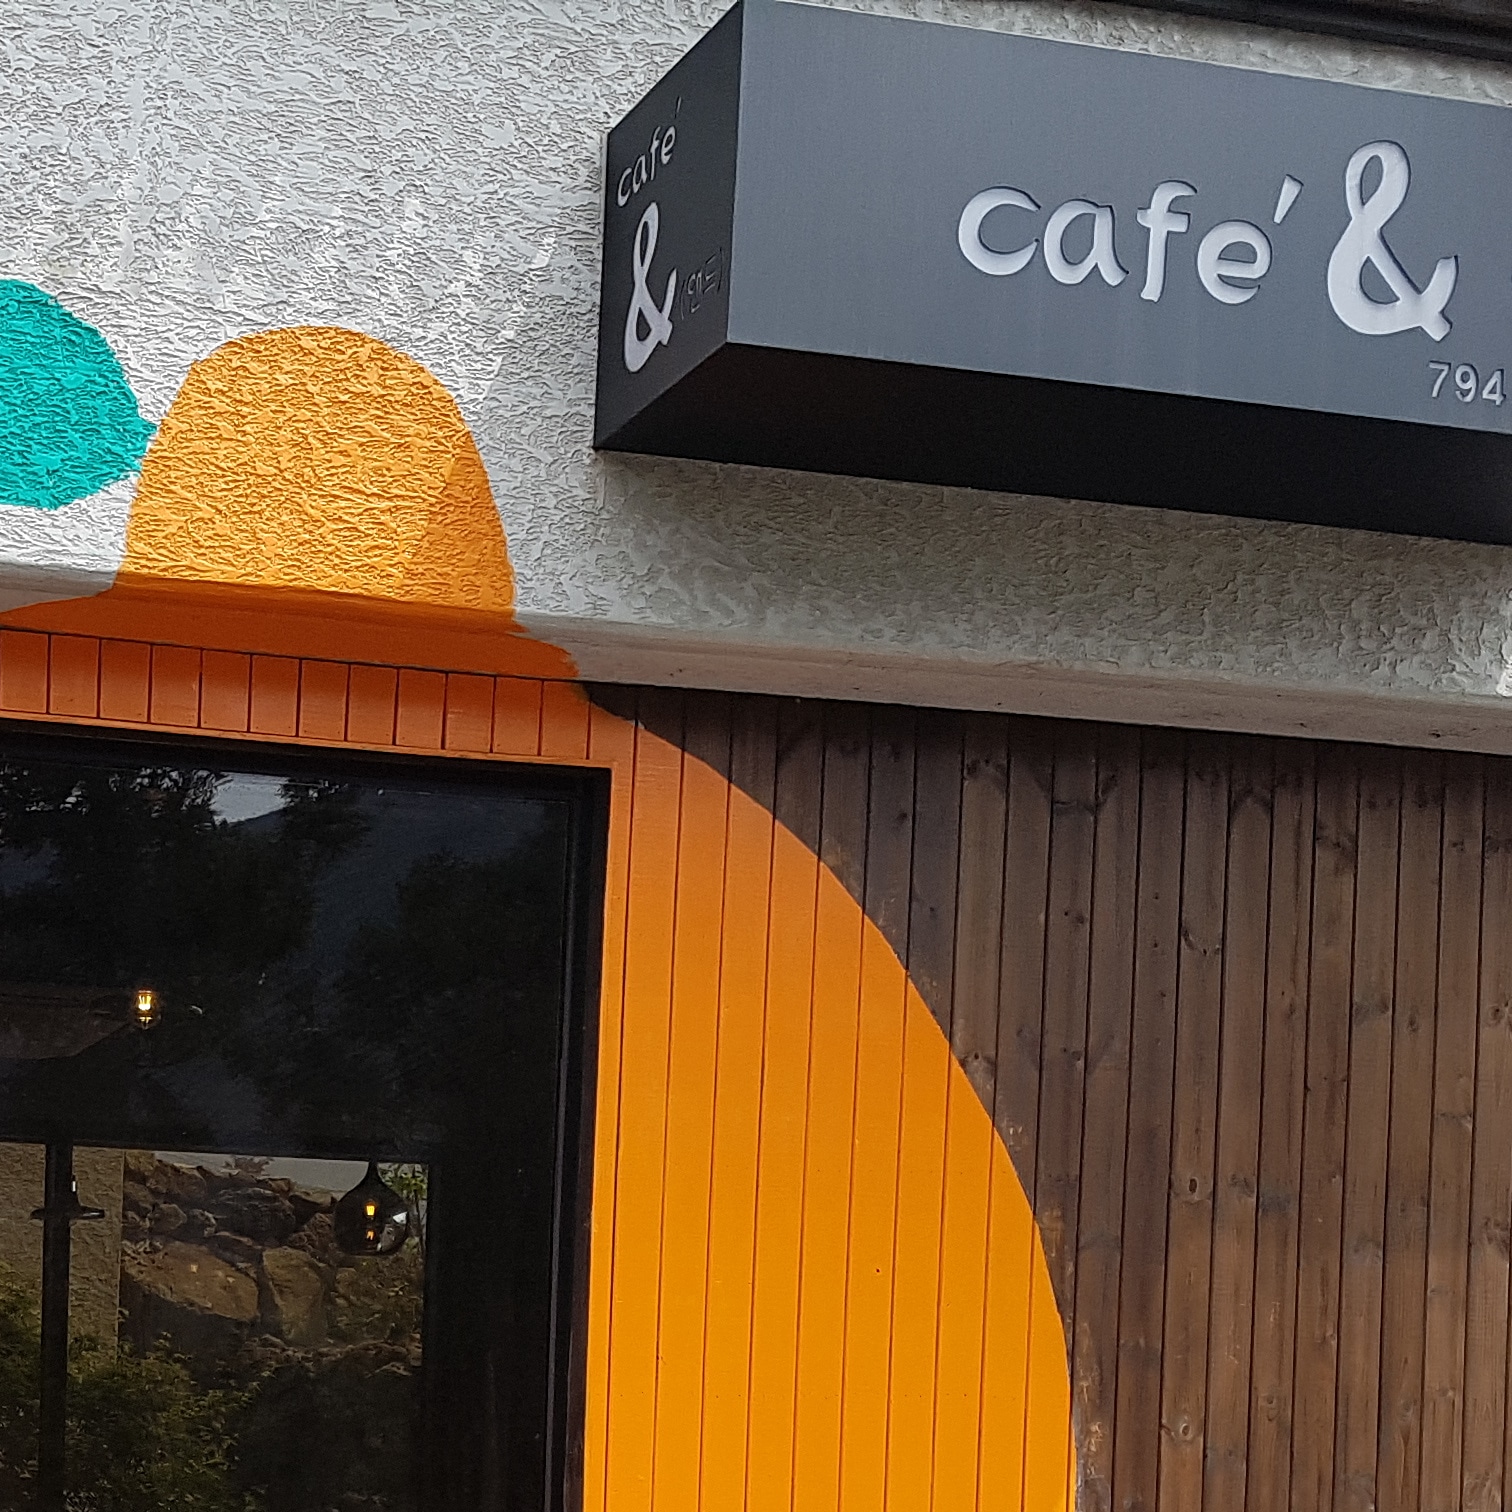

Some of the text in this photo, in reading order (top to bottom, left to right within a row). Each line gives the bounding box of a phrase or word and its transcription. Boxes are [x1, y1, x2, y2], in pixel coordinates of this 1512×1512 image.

[624, 202, 677, 373] &
[1327, 139, 1459, 342] &
[1429, 360, 1506, 406] 794
